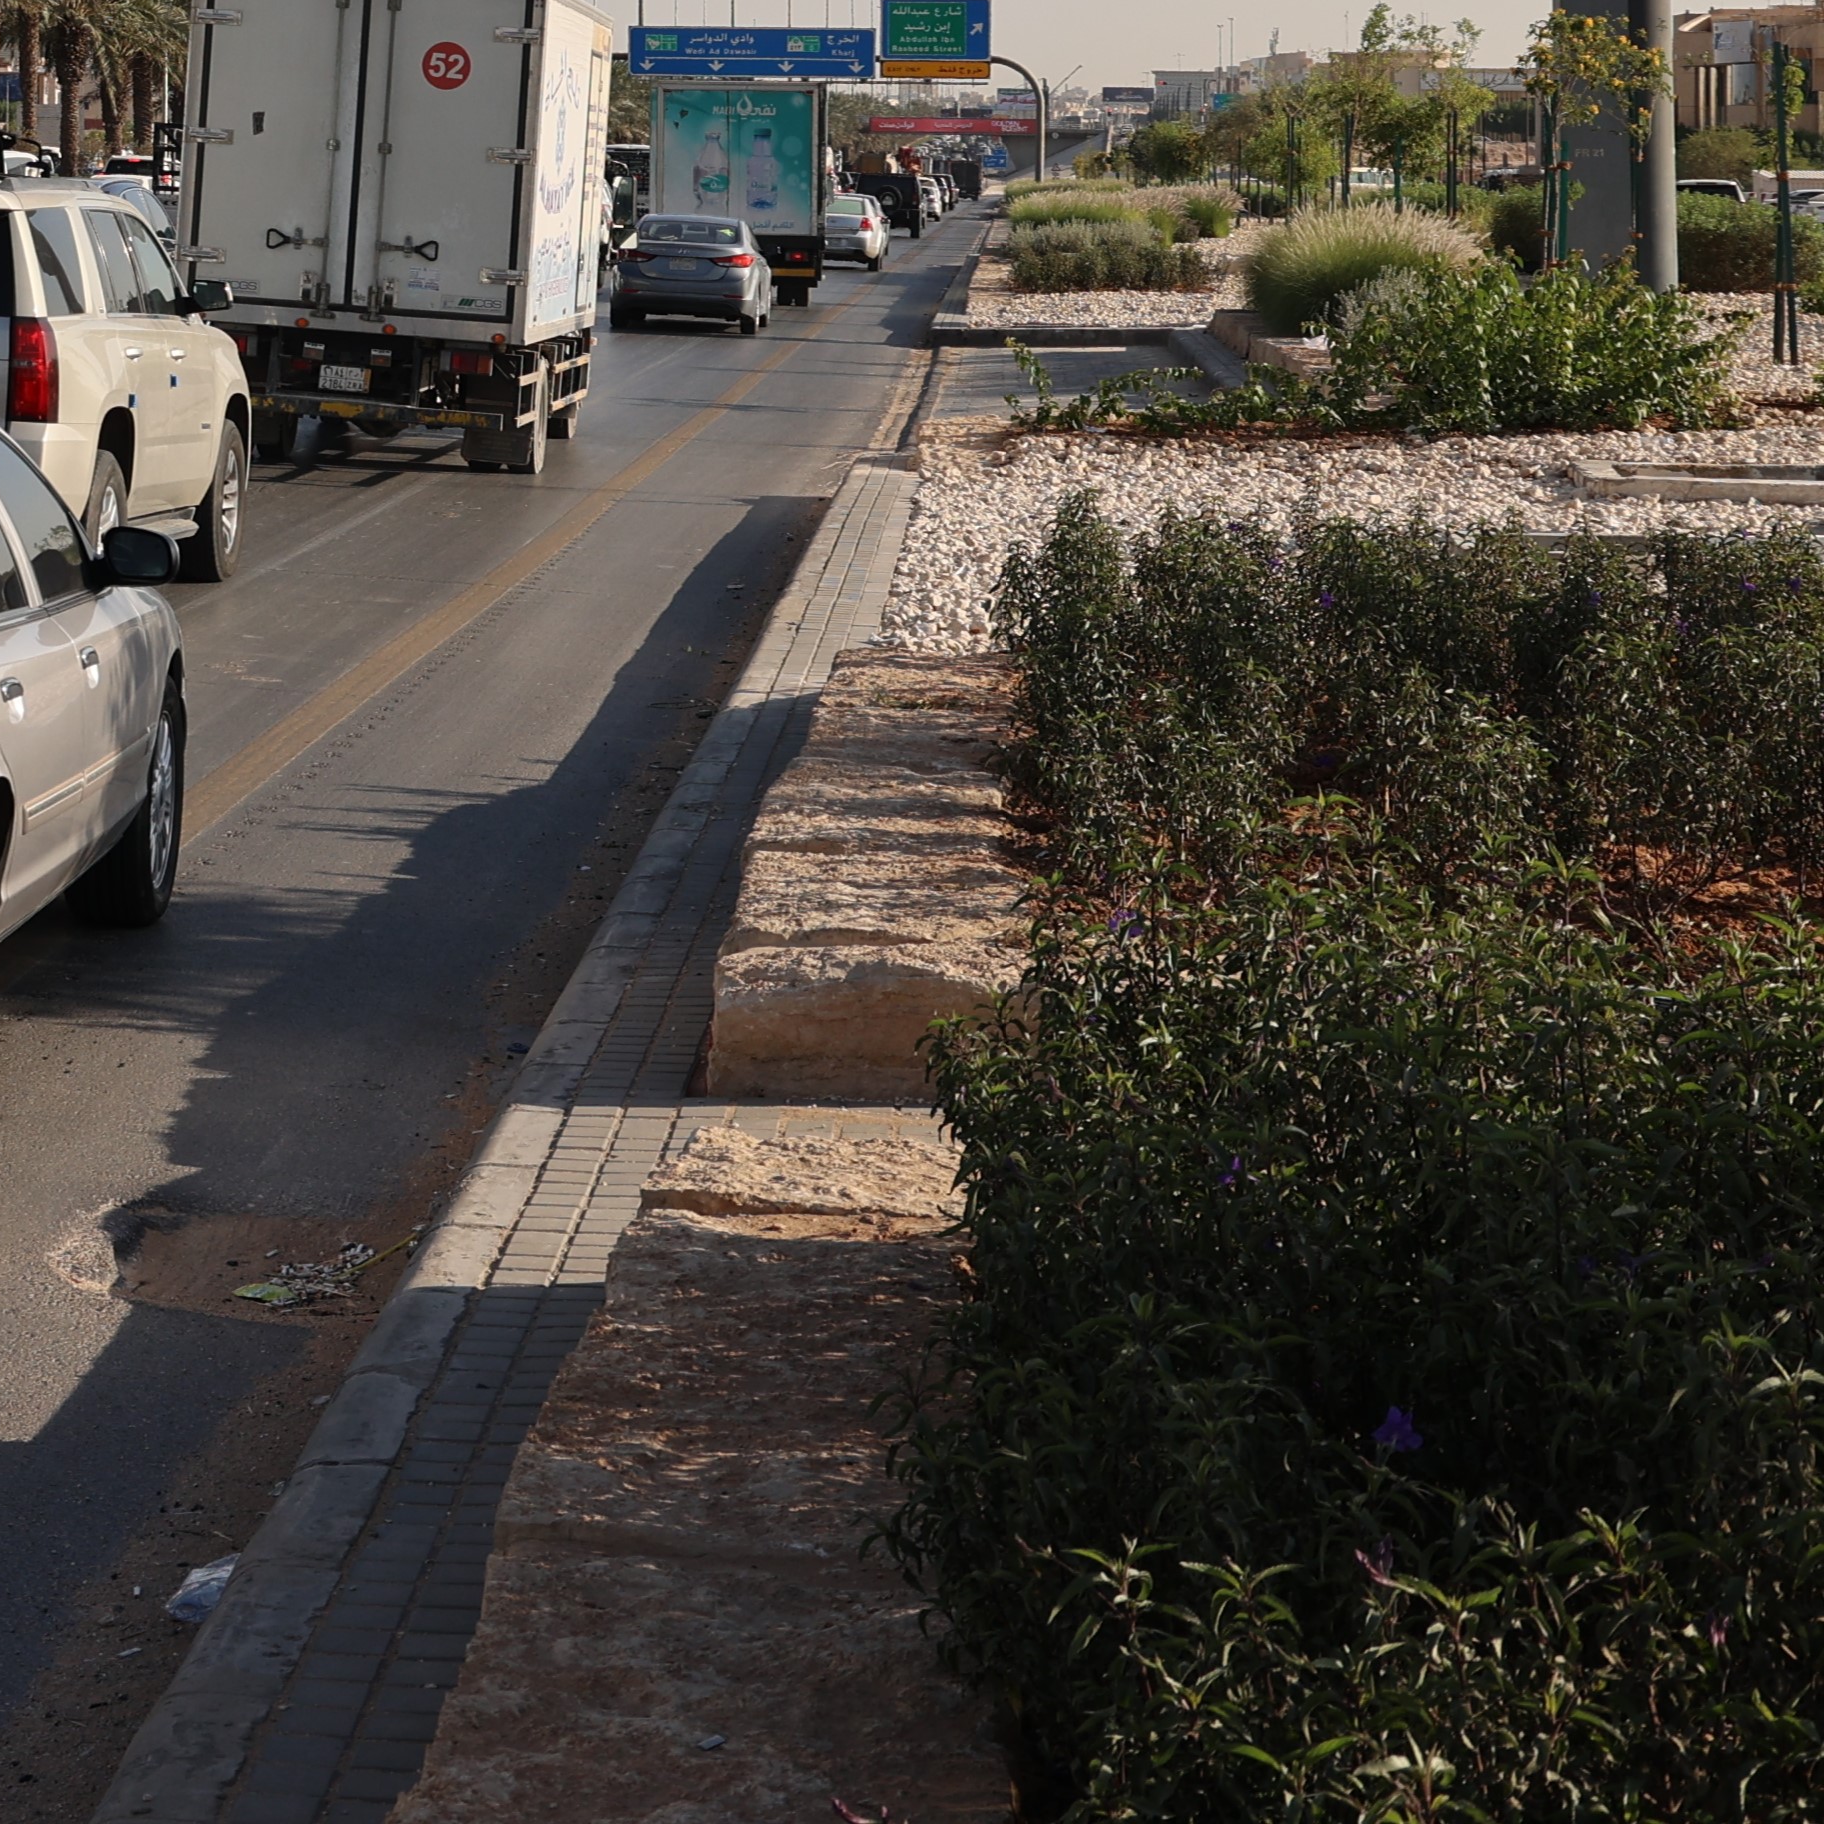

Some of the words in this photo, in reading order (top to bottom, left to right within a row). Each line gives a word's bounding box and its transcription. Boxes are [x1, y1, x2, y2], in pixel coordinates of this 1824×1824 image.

[892, 6, 930, 17] عبدالله
[934, 6, 962, 17] شارع
[904, 21, 931, 32] رشيد
[689, 33, 728, 44] الدواسر
[730, 33, 754, 46] وادي
[827, 34, 859, 46] الخرج
[685, 47, 706, 55] Wadi
[832, 49, 855, 58] Kharj
[428, 52, 465, 80] 52
[320, 377, 343, 389] 2184
